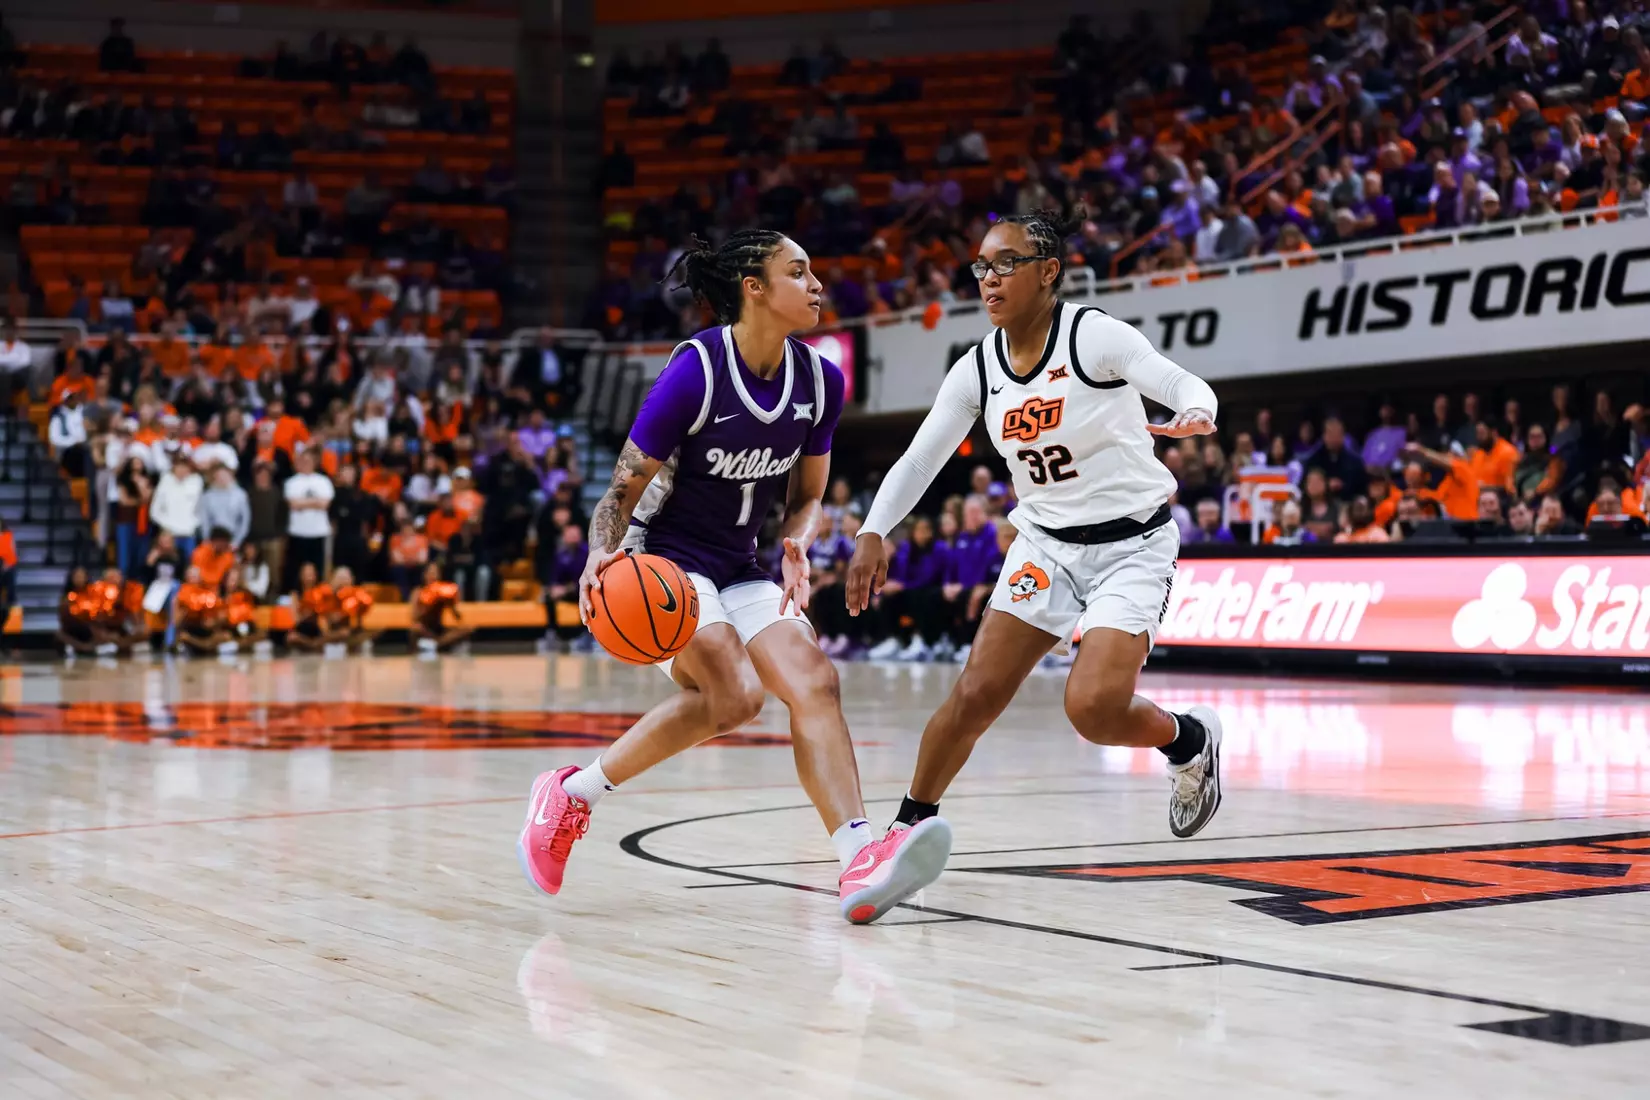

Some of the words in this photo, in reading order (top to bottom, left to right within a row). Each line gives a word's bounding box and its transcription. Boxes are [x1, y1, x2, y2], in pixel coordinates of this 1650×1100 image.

[1157, 307, 1219, 351] TO
[1002, 396, 1065, 443] OSU
[1016, 444, 1079, 485] 32
[735, 481, 757, 526] 1
